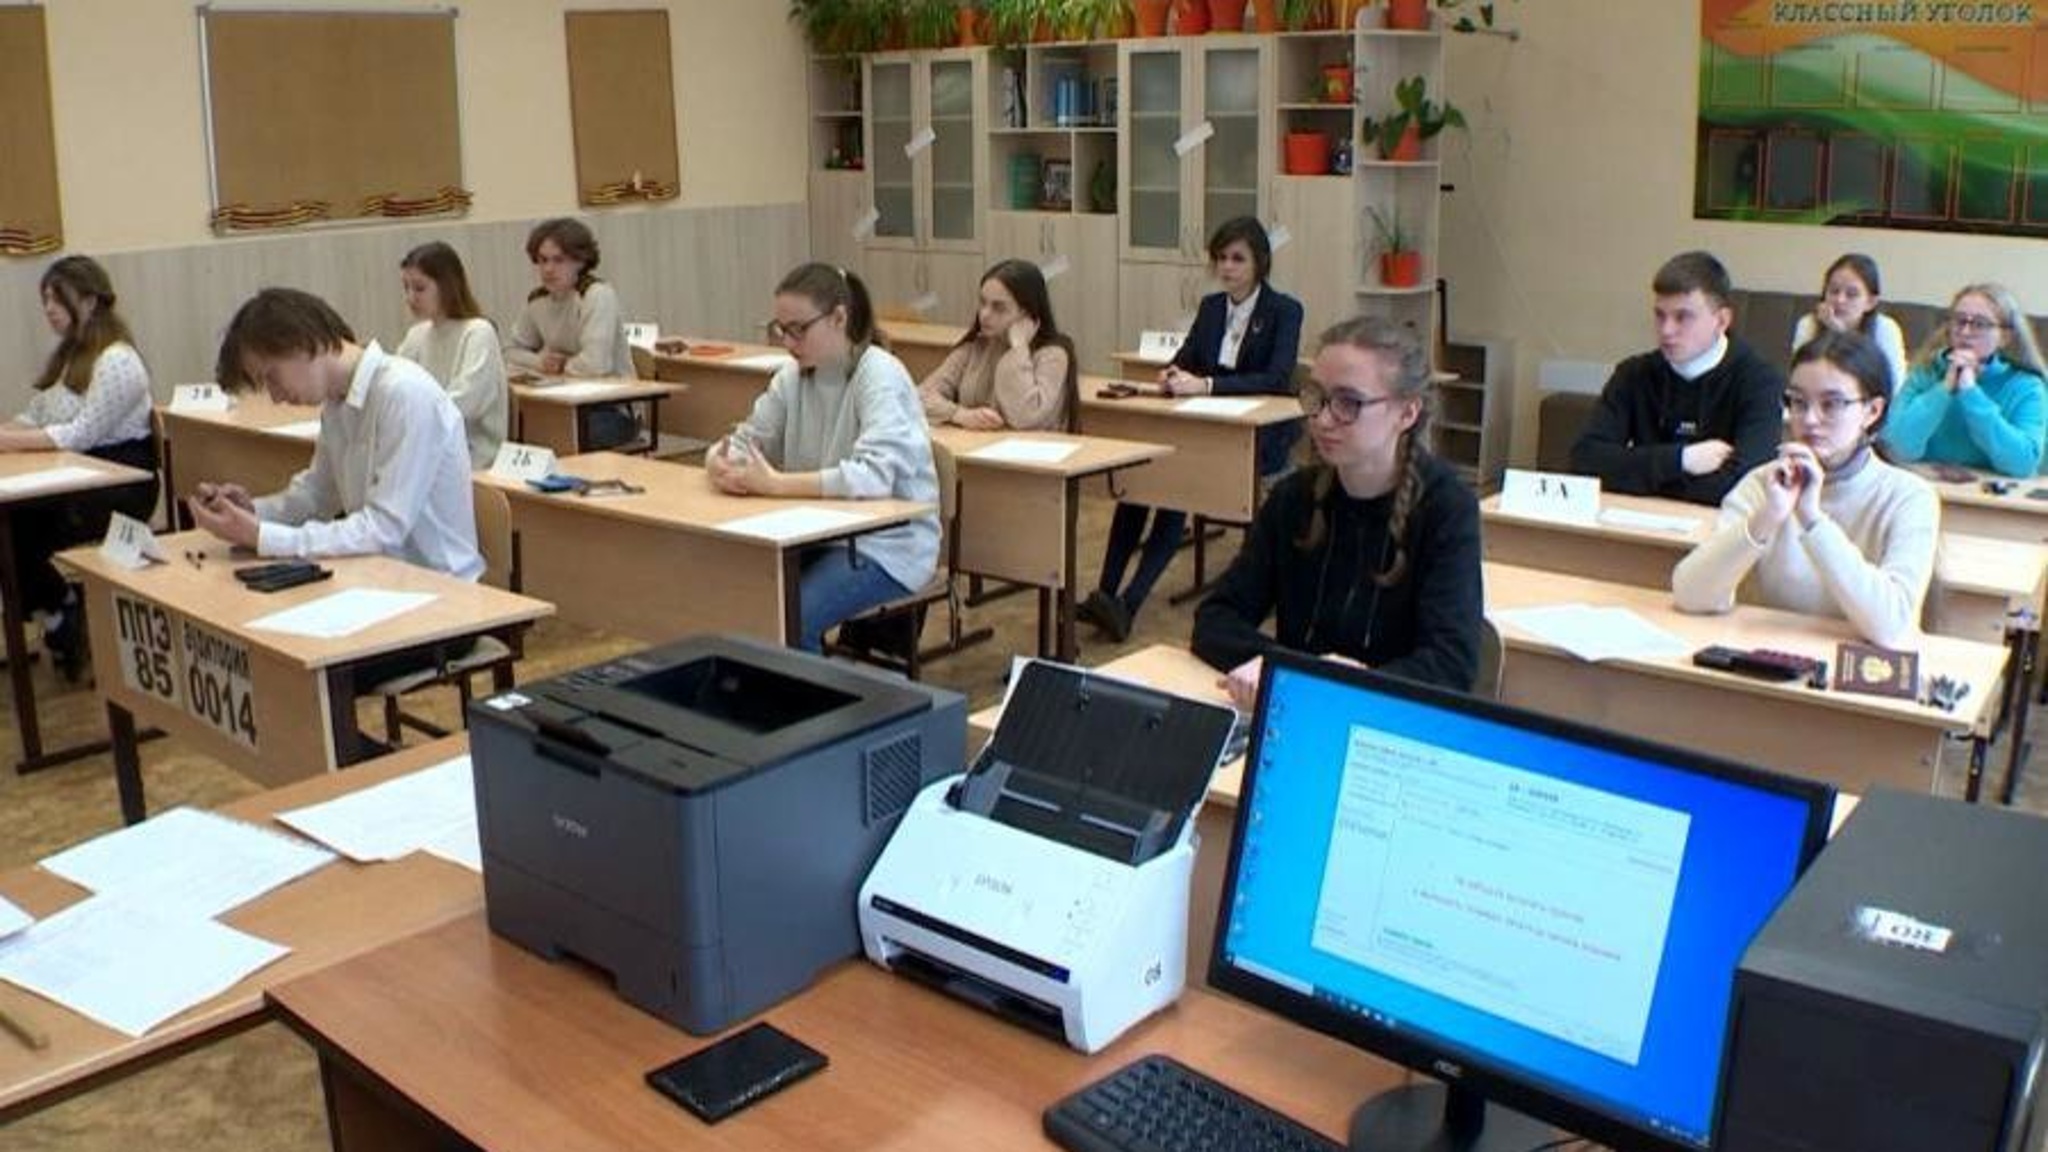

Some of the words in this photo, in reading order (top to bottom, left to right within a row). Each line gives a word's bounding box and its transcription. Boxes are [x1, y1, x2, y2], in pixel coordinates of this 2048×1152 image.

[1774, 1, 1917, 22] КЛАССНЫЙ
[1926, 4, 2031, 22] УГОЛОК
[116, 597, 171, 651] ППЭ
[134, 647, 173, 697] 85
[190, 664, 256, 746] 0014
